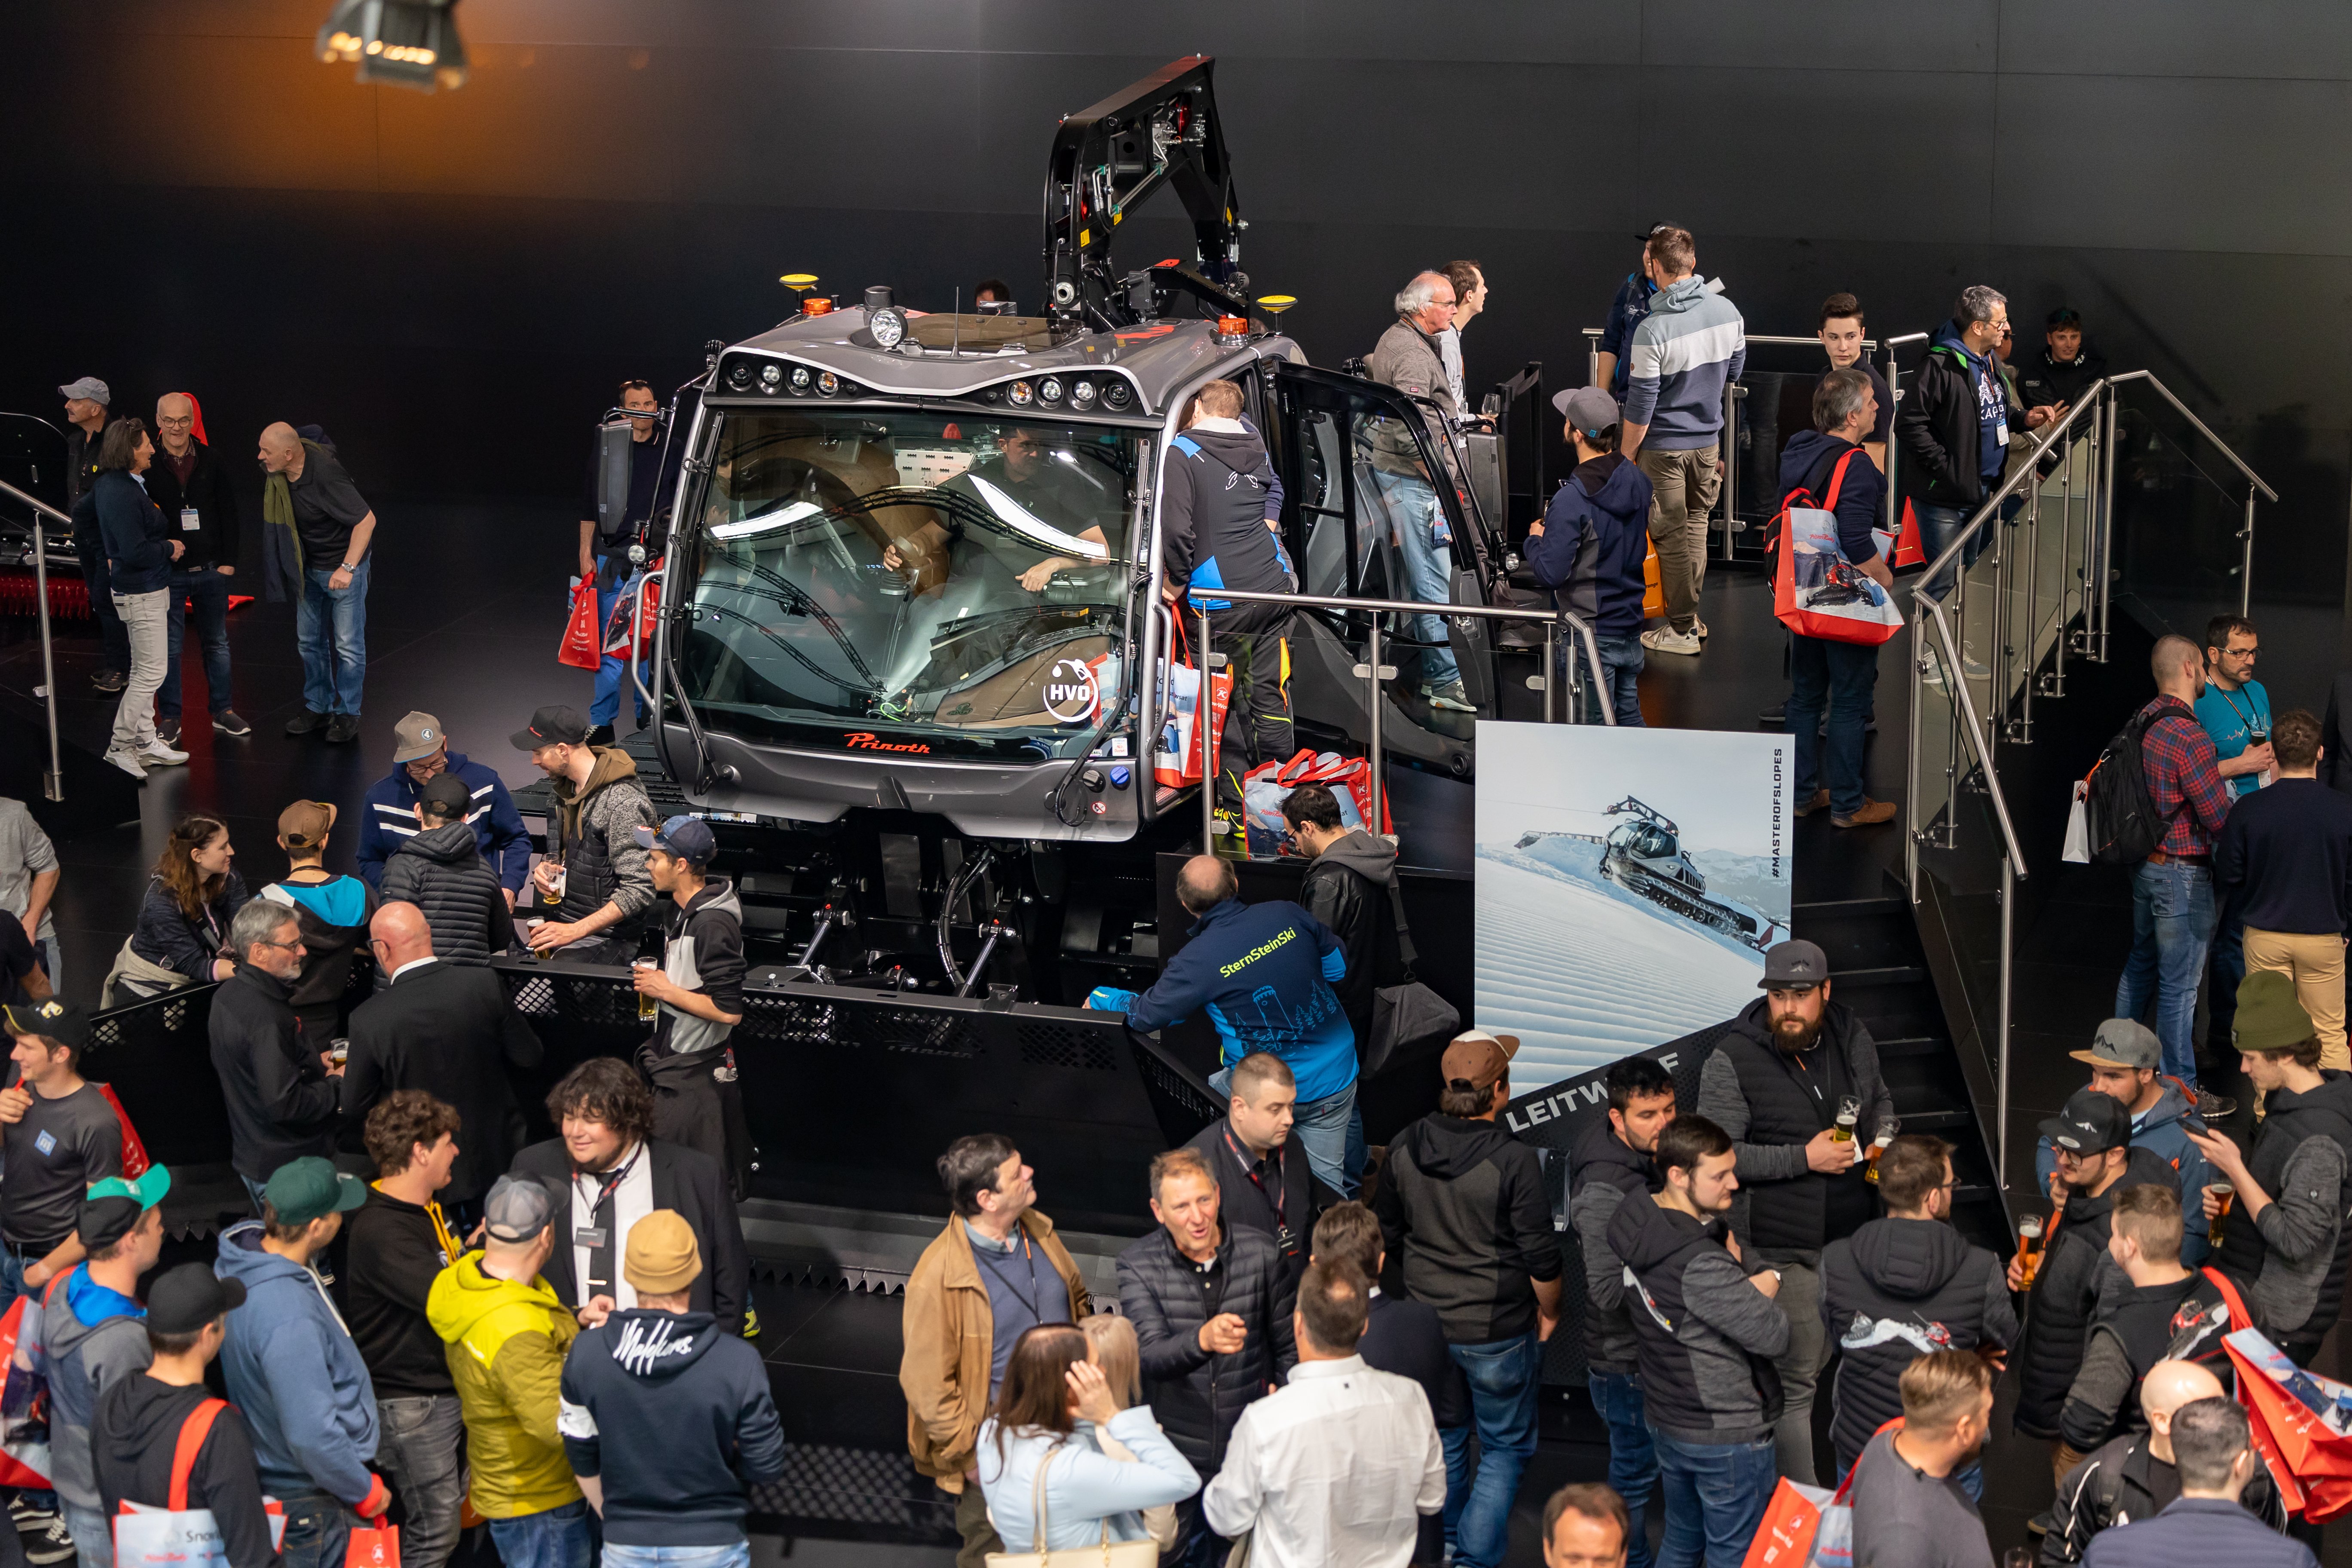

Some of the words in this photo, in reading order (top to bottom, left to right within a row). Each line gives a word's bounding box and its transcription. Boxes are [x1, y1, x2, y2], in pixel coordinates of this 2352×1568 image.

[1050, 684, 1090, 701] HVO
[844, 733, 930, 753] Prinoth
[1771, 748, 1782, 879] #MASTEROFSLOPES
[1220, 927, 1296, 978] SternSteinSki
[1505, 1052, 1679, 1133] LEITWF
